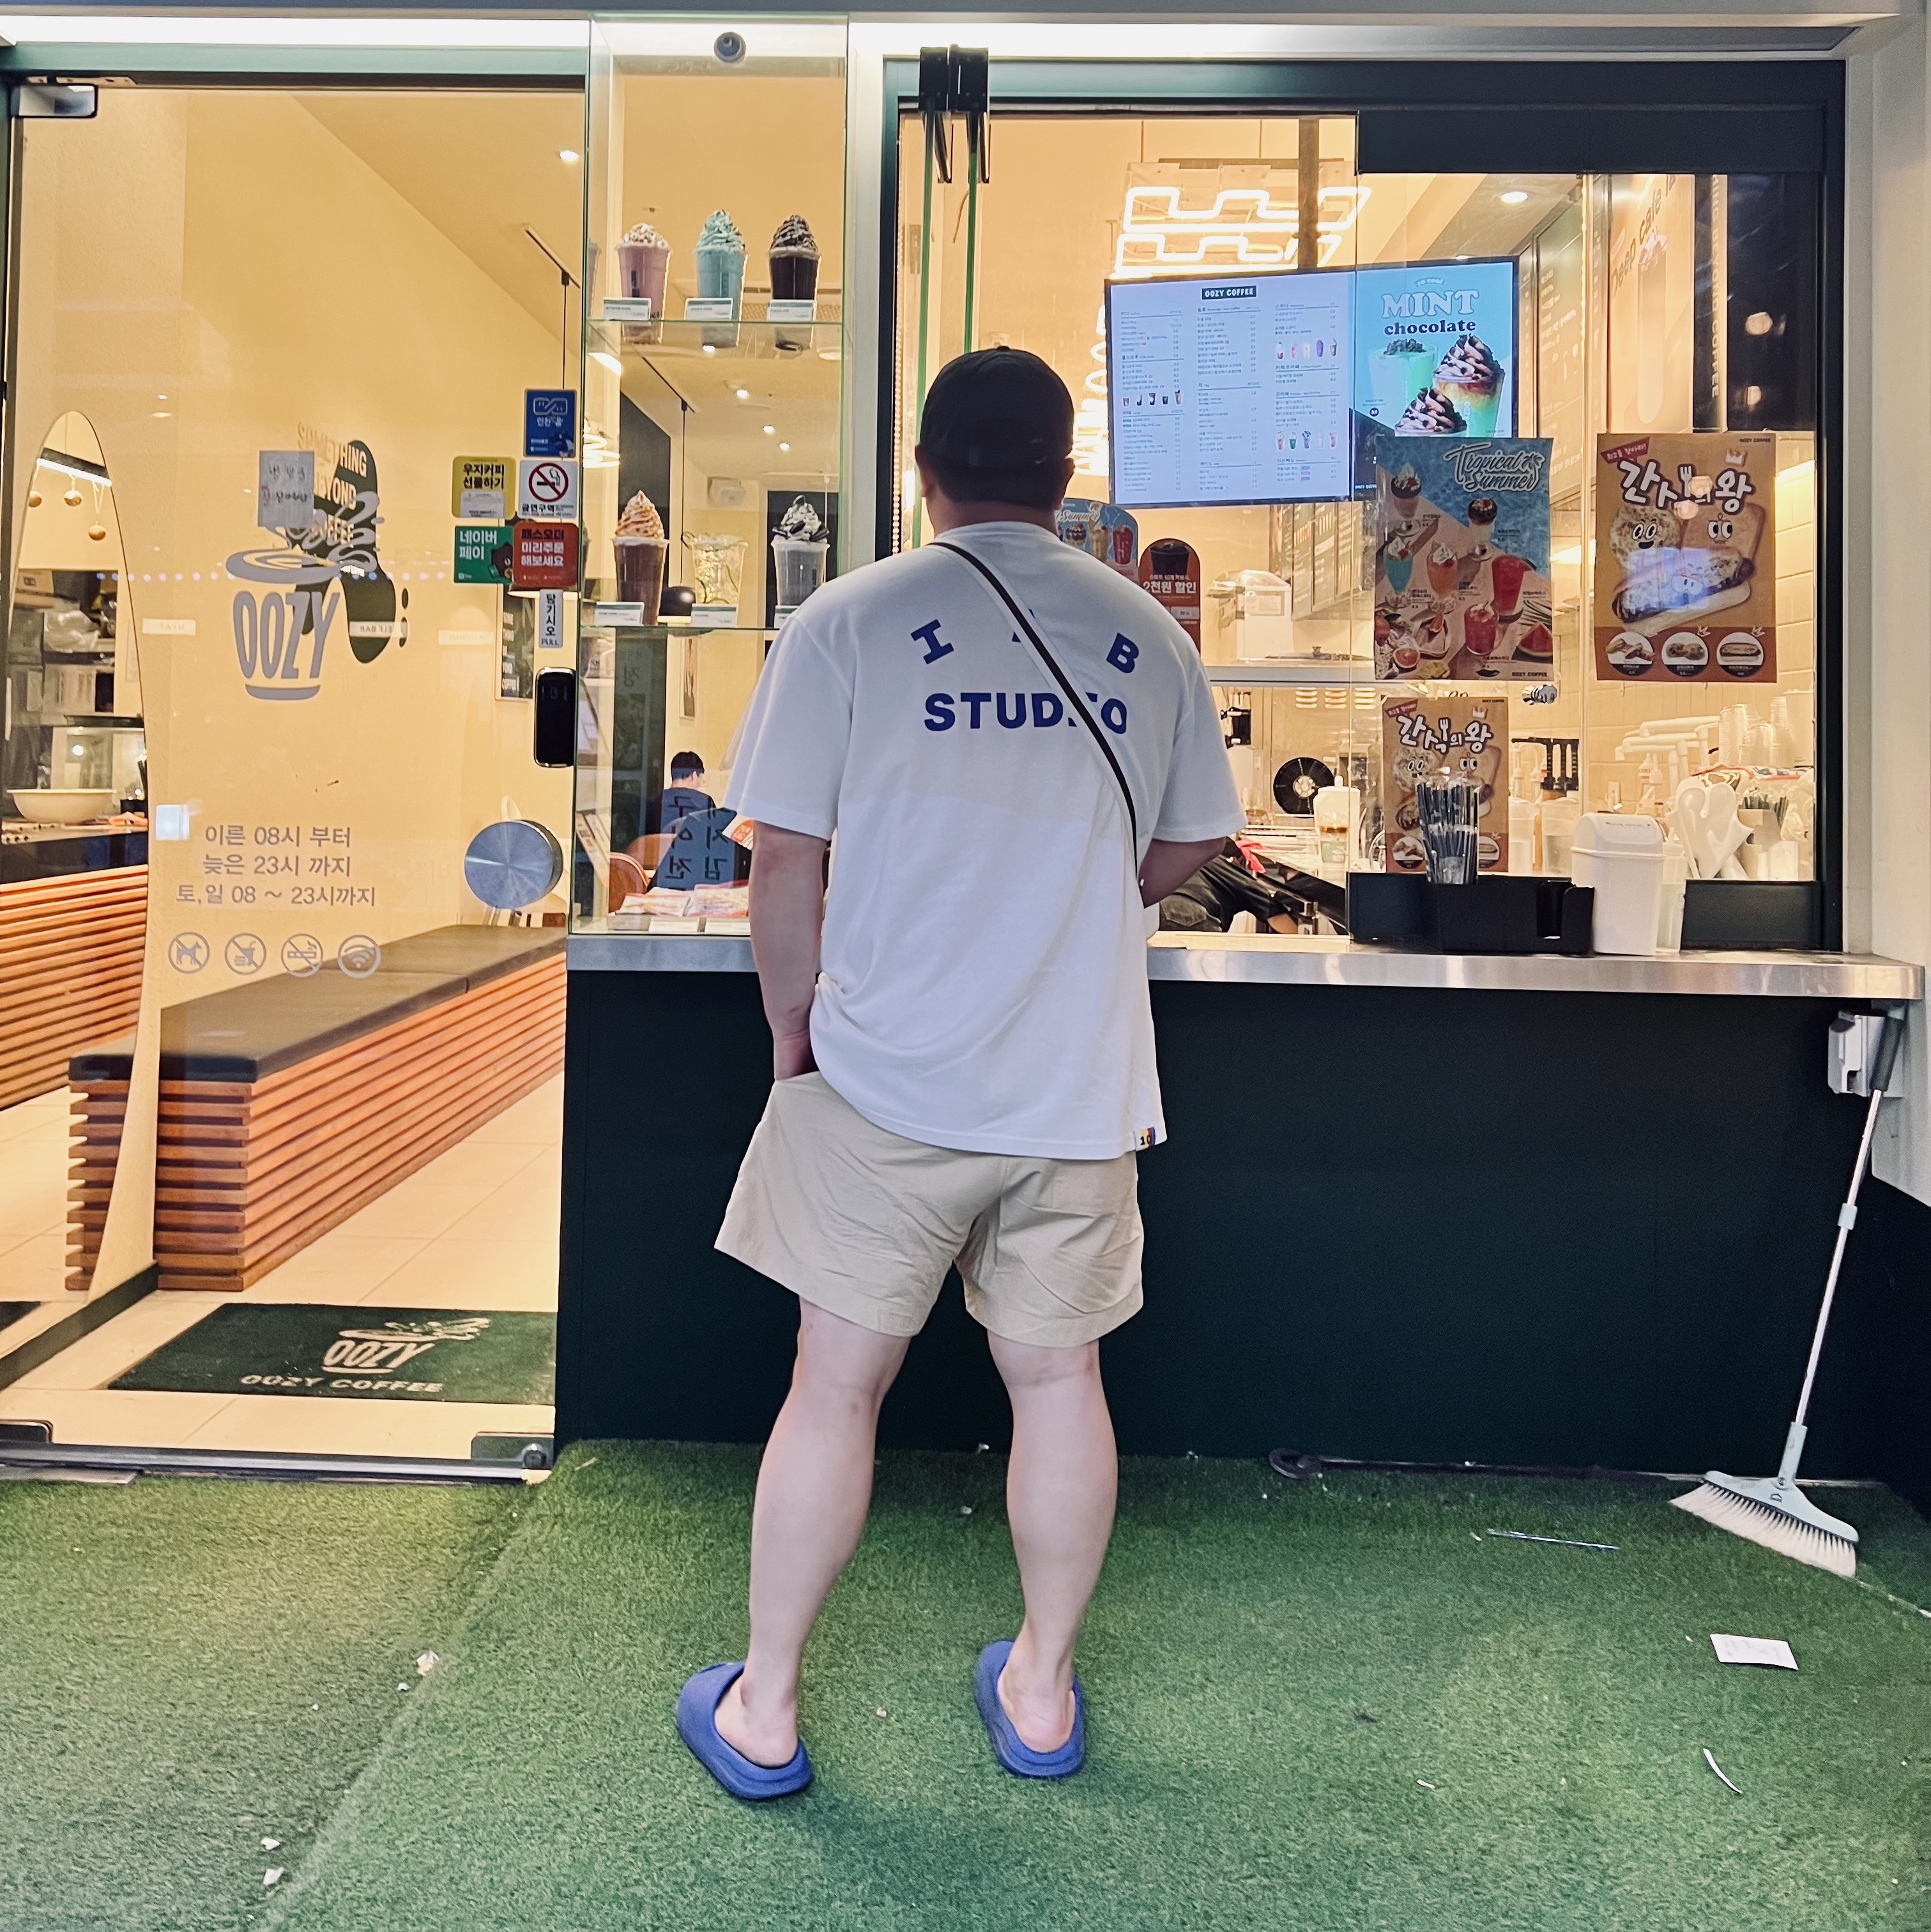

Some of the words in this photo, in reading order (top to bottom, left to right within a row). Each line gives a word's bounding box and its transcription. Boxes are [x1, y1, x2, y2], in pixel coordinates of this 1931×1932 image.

[1226, 288, 1253, 296] COFFEE
[1381, 289, 1479, 318] MINT
[1384, 319, 1476, 335] chocolate
[463, 463, 505, 476] 우지커피
[1444, 442, 1525, 484] Tropical
[463, 476, 504, 489] 선물하기
[1465, 471, 1536, 491] Summer
[1715, 469, 1753, 513] 왕
[459, 529, 498, 545] 네이버
[521, 541, 564, 554] 미리주문
[459, 545, 485, 561] 페이
[521, 554, 564, 568] 해보세요
[1143, 581, 1172, 594] 2천원
[1175, 581, 1196, 594] 할인
[546, 593, 556, 636] 당기시오
[233, 590, 340, 679] OOZY
[1106, 632, 1140, 674] B
[924, 692, 1127, 734] STUDO
[1398, 715, 1463, 754] 간식의
[1465, 722, 1492, 753] 왕
[204, 825, 246, 846] 이른
[254, 826, 301, 847] 08시
[309, 826, 351, 848] 부터
[202, 853, 245, 875] 늦은
[254, 855, 300, 876] 23시
[309, 855, 351, 877] 까지
[176, 884, 223, 905] 토,일
[231, 886, 256, 904] 08
[291, 886, 376, 906] 23시까지
[323, 1340, 435, 1368] OOZY
[241, 1375, 324, 1388] OOZY
[329, 1379, 443, 1394] COFFEE
